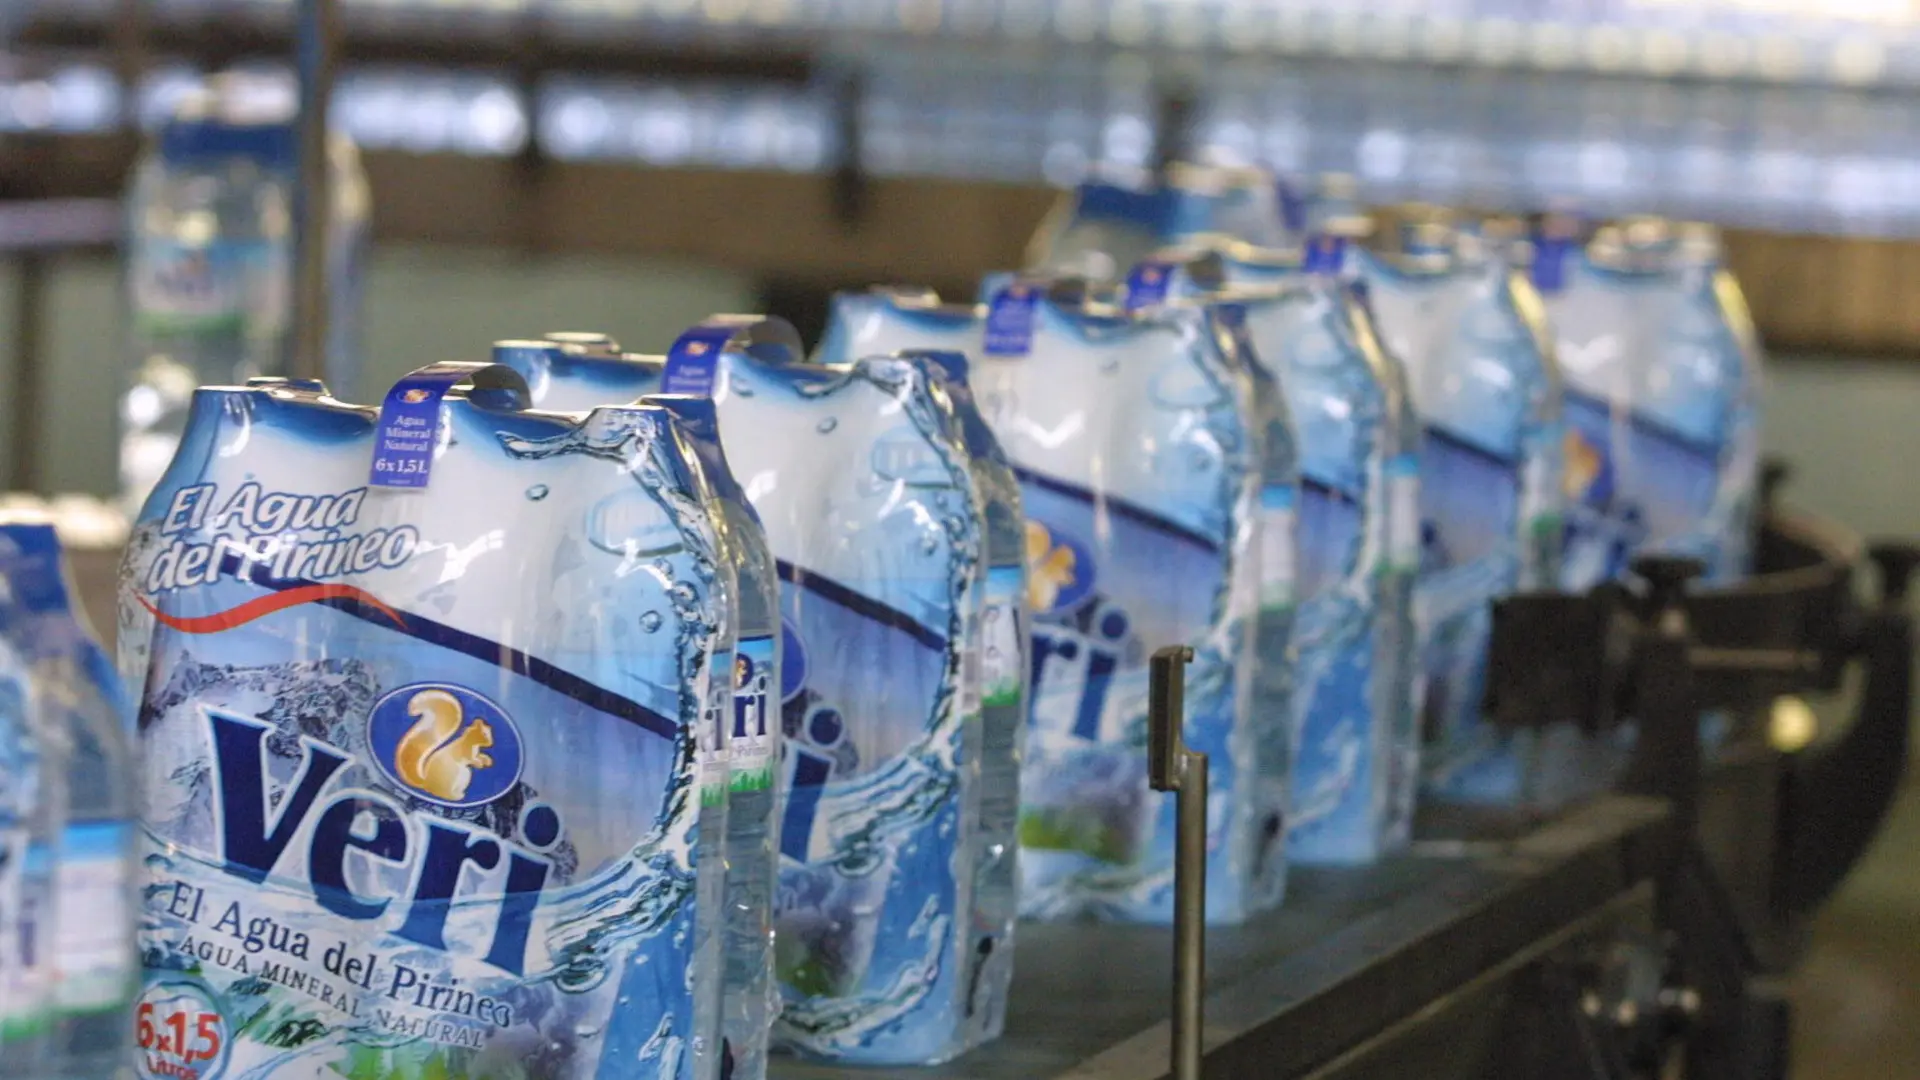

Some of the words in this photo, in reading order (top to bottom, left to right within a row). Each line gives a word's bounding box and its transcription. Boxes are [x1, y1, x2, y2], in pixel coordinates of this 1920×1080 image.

[384, 439, 429, 452] Natural
[385, 427, 431, 439] Mineral
[393, 415, 426, 428] Agua
[162, 482, 217, 536] El
[214, 482, 368, 536] Agua
[147, 532, 233, 595] del
[235, 524, 419, 584] Pirineo
[202, 705, 560, 978] Veri
[167, 880, 204, 924] El
[211, 900, 310, 961] Agua
[323, 941, 377, 991] del
[386, 964, 511, 1028] Pirineo
[180, 936, 249, 974] AGUA
[260, 961, 361, 1020] MINERAL
[376, 1009, 484, 1048] NATURAL
[136, 1002, 221, 1065] 6x1,5
